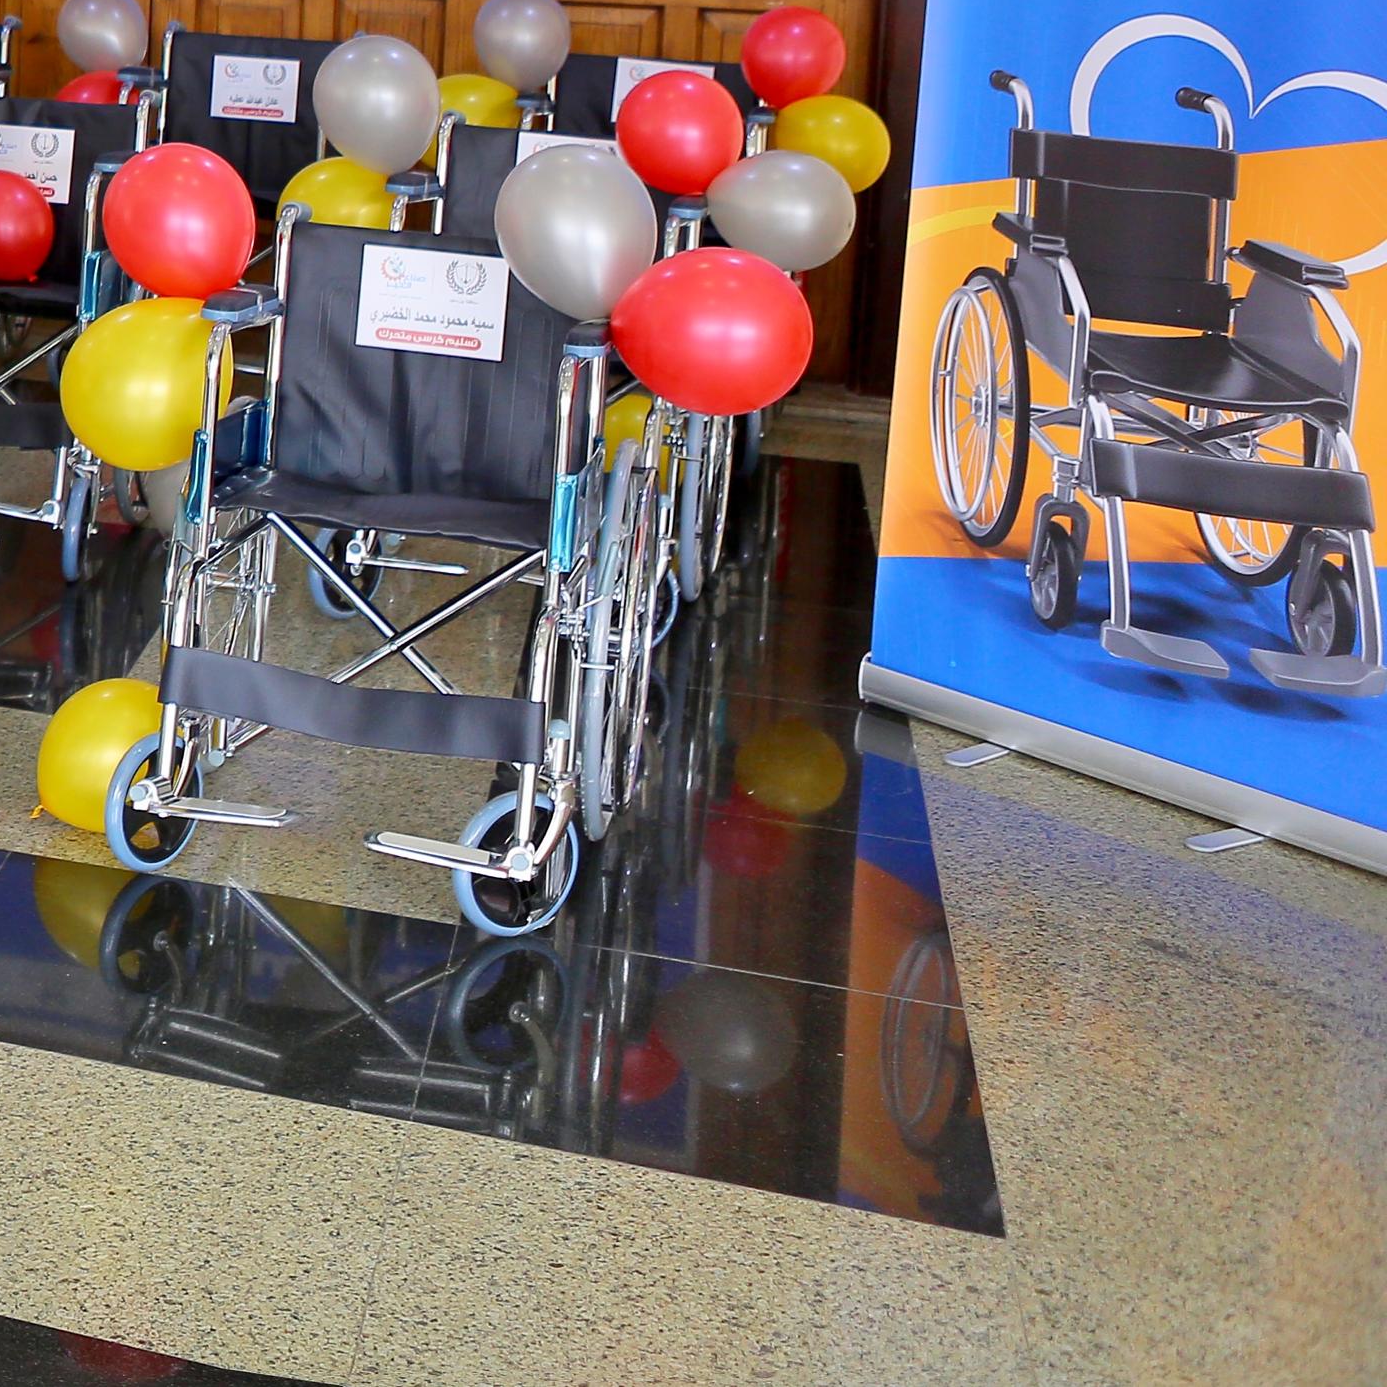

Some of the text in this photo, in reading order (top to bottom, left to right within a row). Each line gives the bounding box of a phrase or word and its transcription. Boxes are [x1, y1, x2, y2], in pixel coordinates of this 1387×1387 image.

[39, 172, 58, 184] حسن
[413, 310, 438, 323] محمد
[440, 313, 469, 330] محمود
[377, 328, 413, 343] متحرك
[444, 335, 480, 349] تسليم
